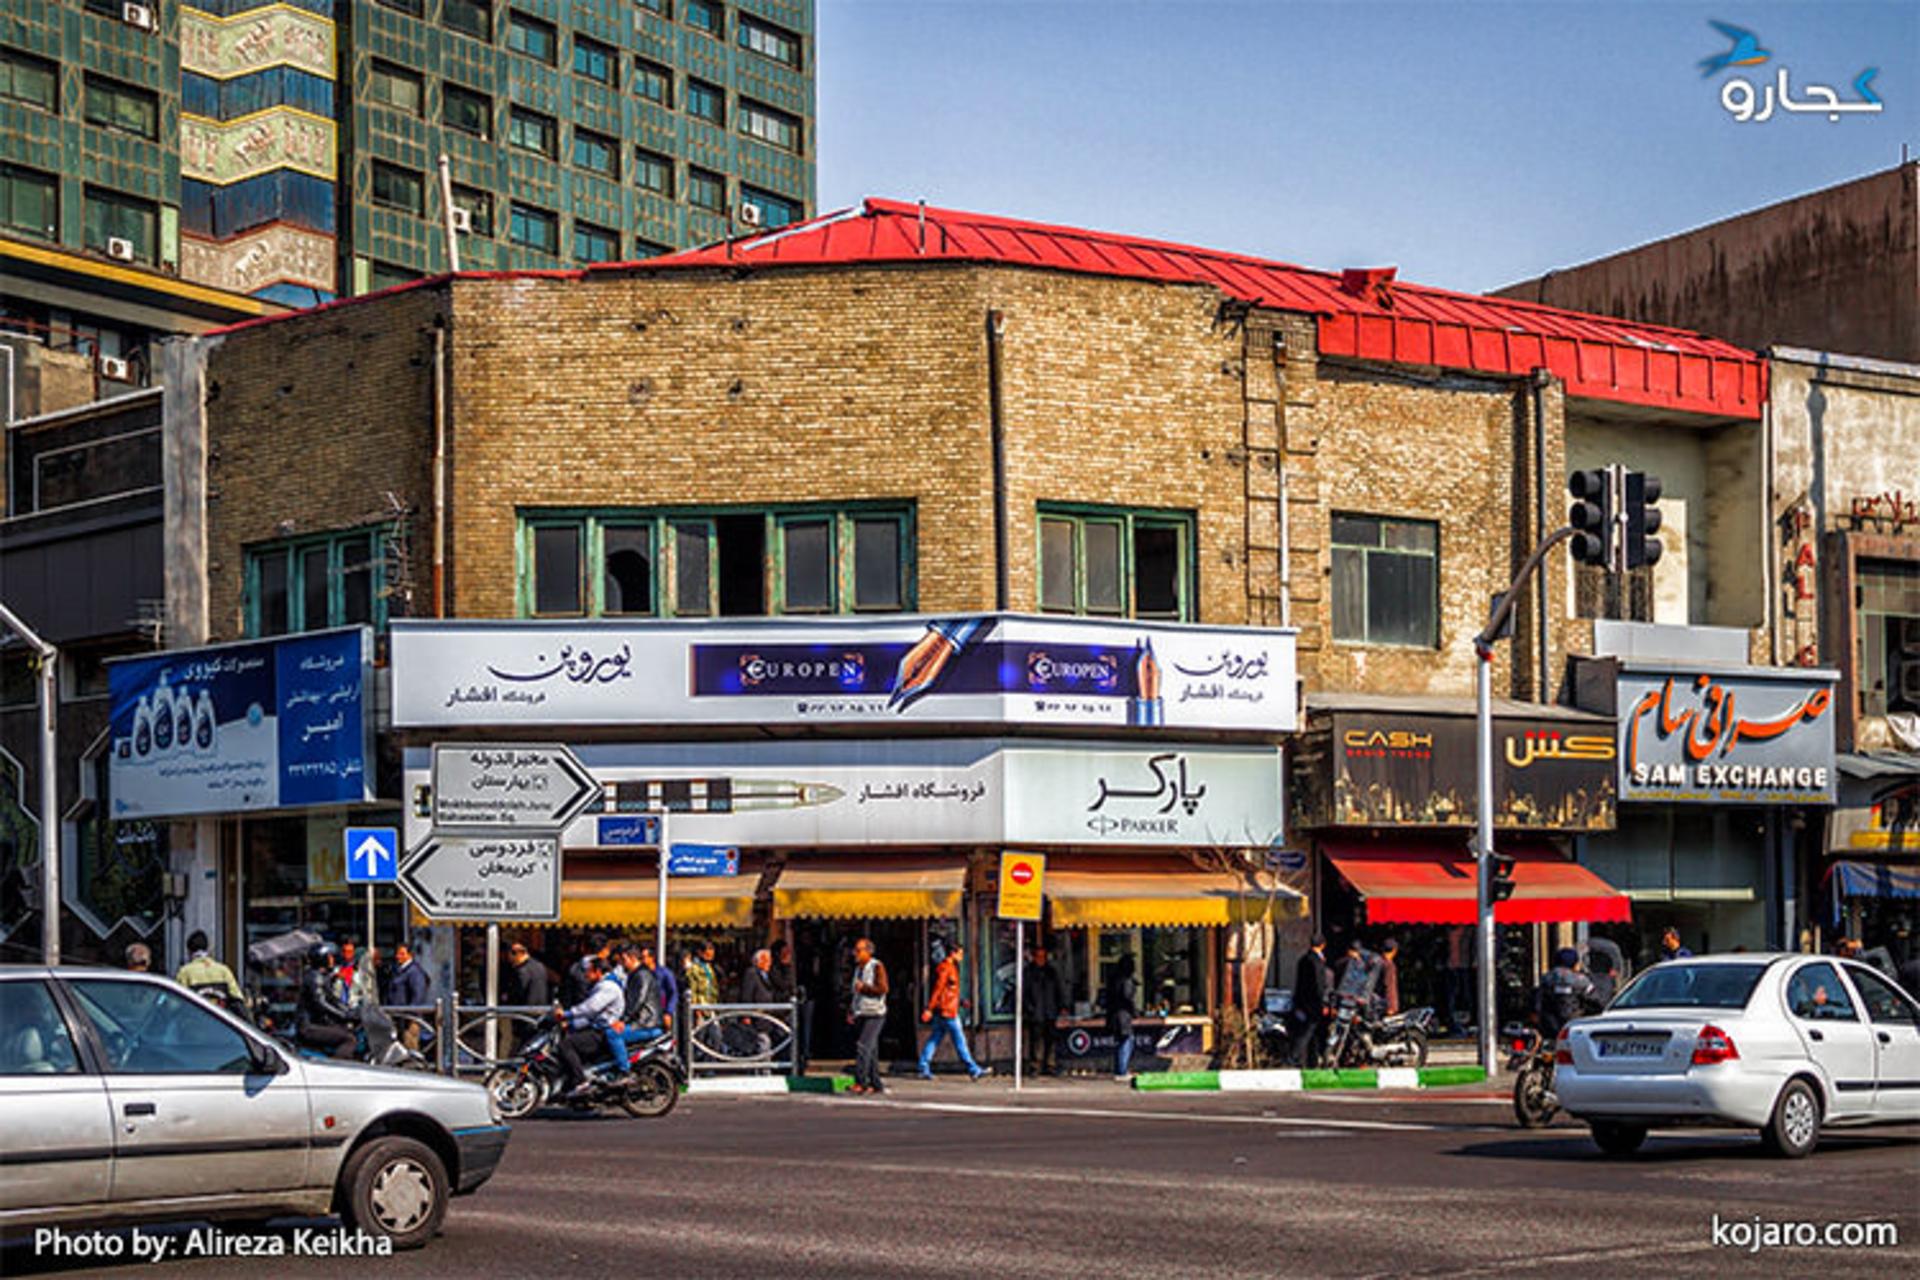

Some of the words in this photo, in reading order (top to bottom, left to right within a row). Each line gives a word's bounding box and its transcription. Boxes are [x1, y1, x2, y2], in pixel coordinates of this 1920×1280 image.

[746, 657, 858, 680] EUROPEN
[1034, 657, 1110, 680] EUROPEN
[446, 687, 498, 707] افشار
[1343, 730, 1433, 748] CASH
[1088, 753, 1207, 816] پارکر
[1635, 763, 1686, 783] SAM
[1697, 765, 1828, 787] EXCHANGE
[858, 781, 909, 804] افشار
[912, 781, 986, 803] فروشگاه
[1120, 819, 1178, 835] PARKER
